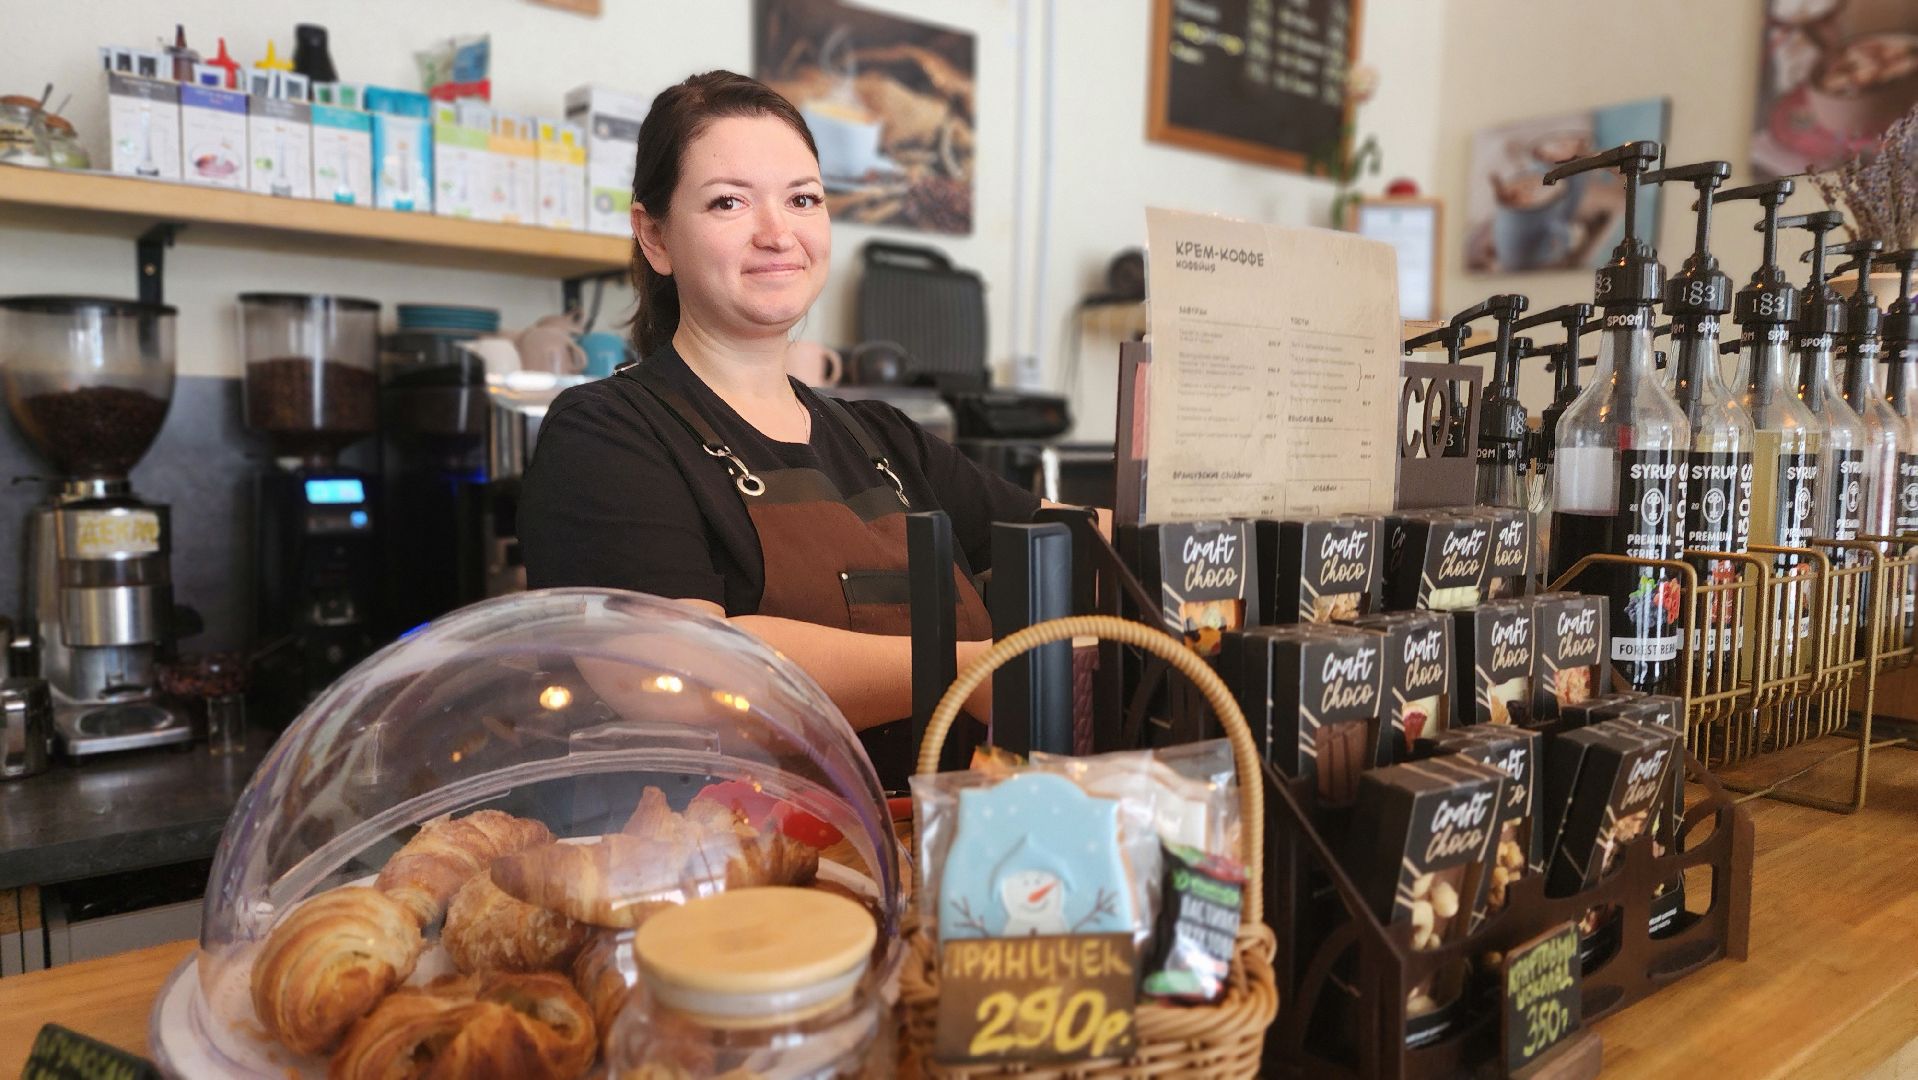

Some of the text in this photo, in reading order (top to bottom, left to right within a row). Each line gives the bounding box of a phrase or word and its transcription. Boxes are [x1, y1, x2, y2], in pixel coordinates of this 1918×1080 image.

[1175, 240, 1264, 267] КРЕМ-КОФФЕ
[1630, 463, 1677, 480] SYRUP
[1692, 464, 1738, 480] SYRUP
[1183, 533, 1237, 564] Craft
[1321, 530, 1368, 560] Craft
[1442, 528, 1486, 557] Craft
[1499, 520, 1524, 547] aft
[1627, 534, 1671, 546] PREMIUM
[1688, 530, 1733, 542] PREMIUM
[1438, 550, 1480, 580] Choco
[1494, 541, 1523, 567] hoco
[1184, 558, 1238, 592] Choco
[1320, 554, 1366, 586] Choco
[1491, 616, 1529, 646] Craft
[1557, 608, 1596, 636] Craft
[1403, 630, 1442, 664] Craft
[1492, 640, 1529, 672] Choco
[1558, 631, 1596, 660] Choco
[1322, 647, 1376, 684] Craft
[1405, 656, 1443, 691] Choco
[1321, 676, 1374, 714] Choco
[1627, 749, 1669, 785] Craft
[1431, 791, 1493, 833] Craft
[1425, 823, 1483, 863] Choco
[943, 937, 1132, 982] ПРЯНИЧЕК
